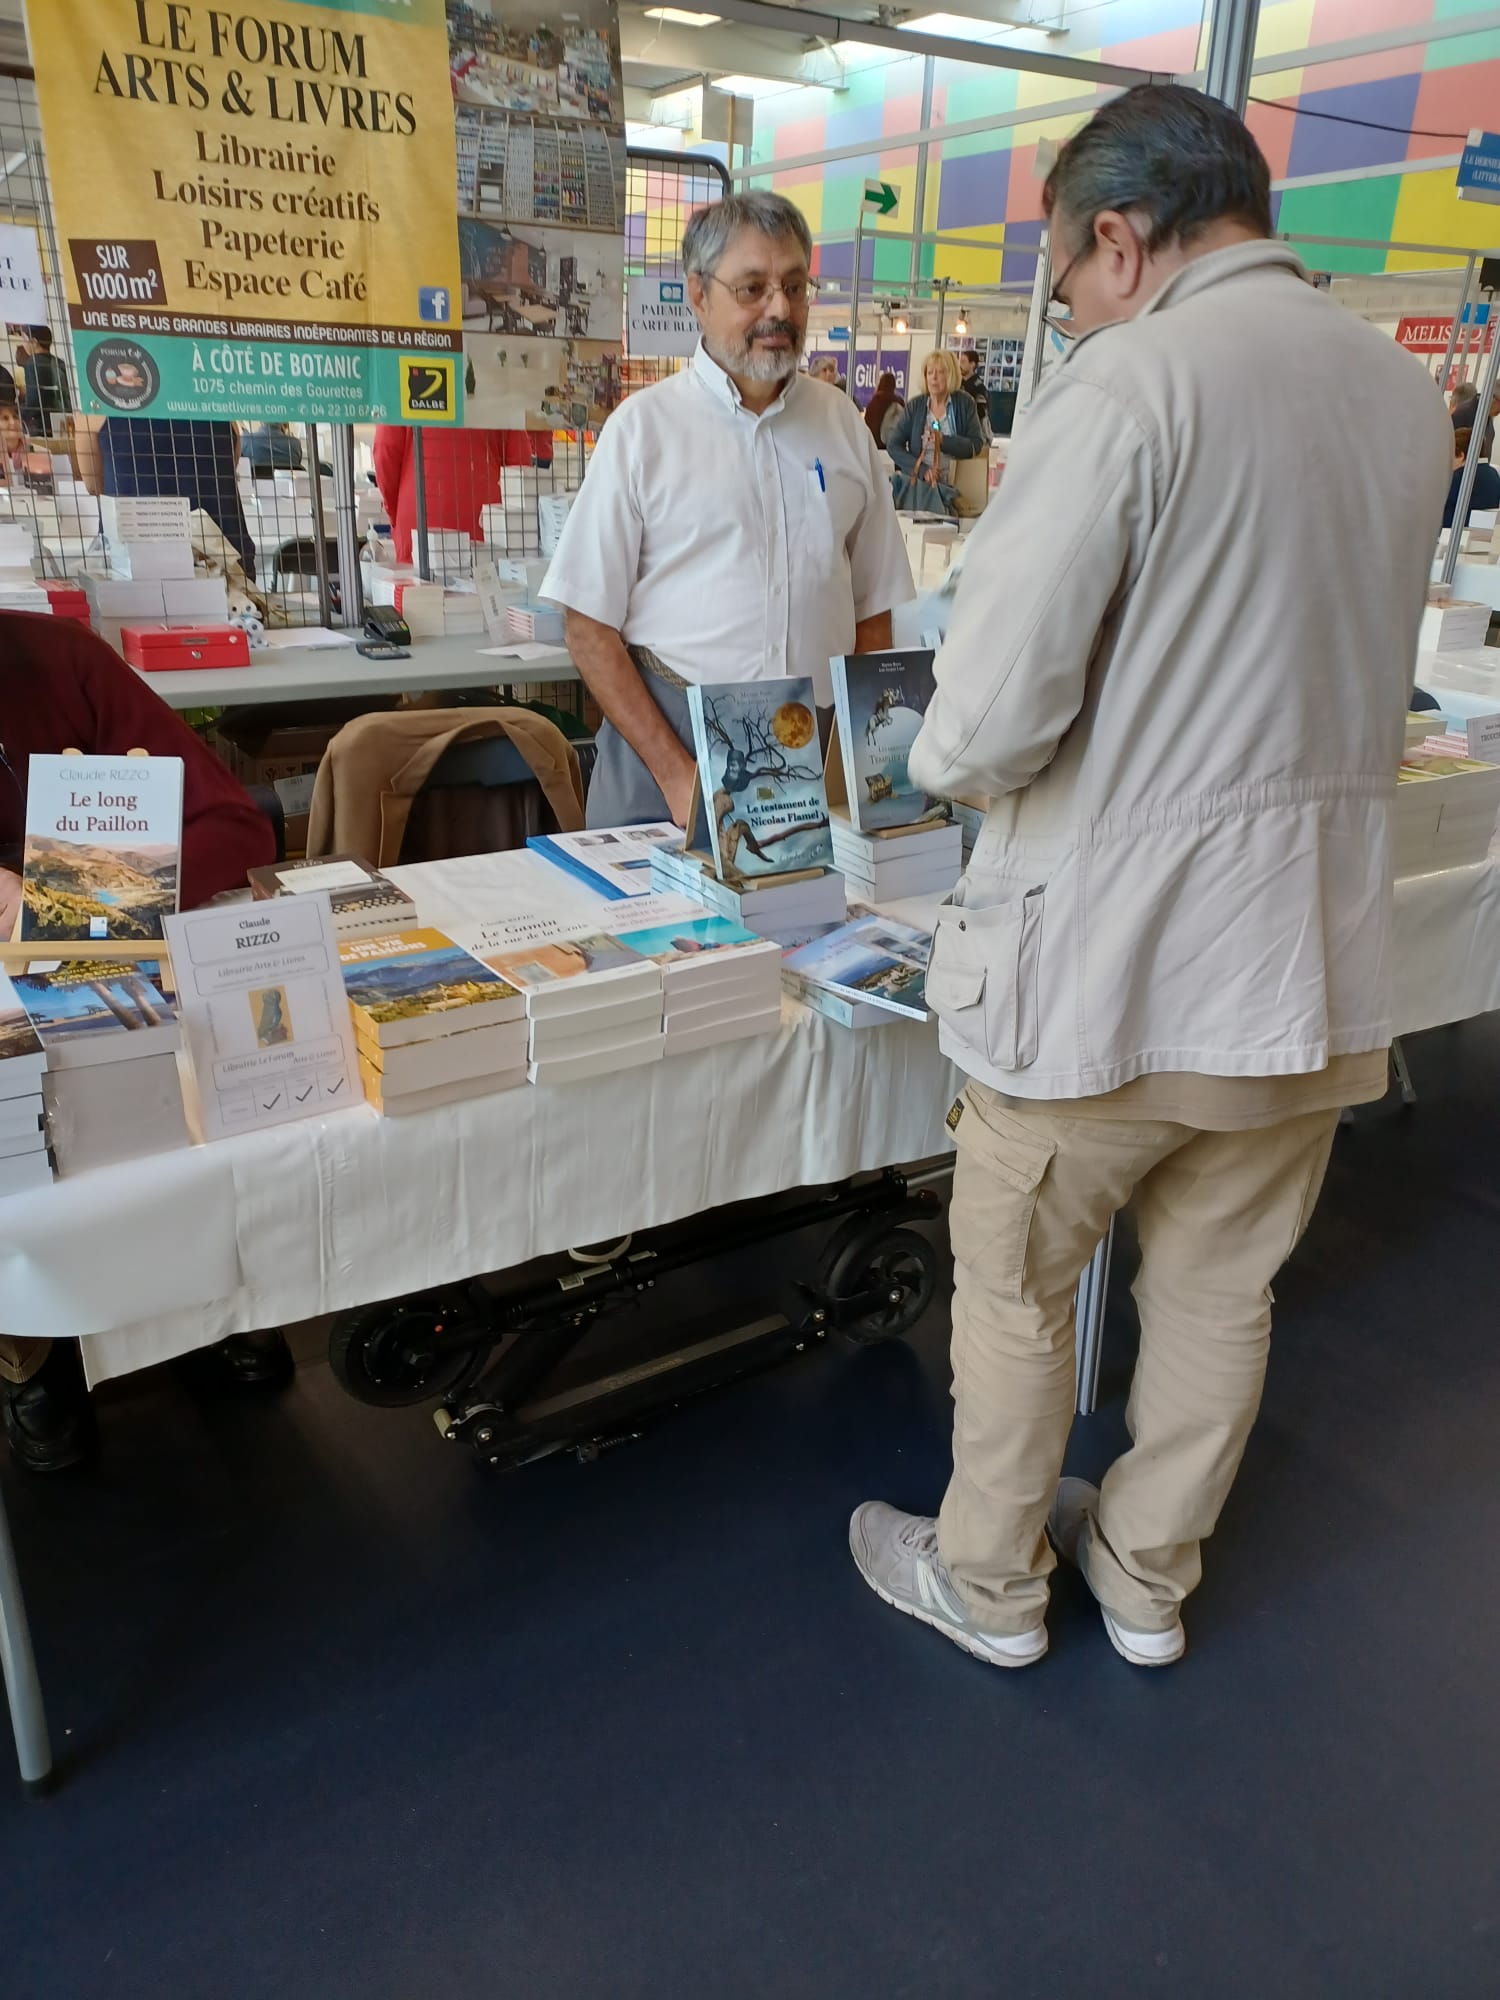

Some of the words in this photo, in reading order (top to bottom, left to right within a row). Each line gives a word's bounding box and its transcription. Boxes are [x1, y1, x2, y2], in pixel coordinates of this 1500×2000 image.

[135, 0, 197, 53] LE
[207, 9, 368, 79] FORUM
[94, 50, 210, 110] ARTS
[221, 70, 256, 116] &
[265, 75, 417, 136] LIVRES
[195, 130, 336, 176] Librairie
[152, 169, 264, 212] Loisirs
[272, 185, 380, 222] créatifs
[200, 219, 345, 260] Papeterie
[96, 244, 130, 270] SUR
[82, 272, 131, 301] 1000
[184, 259, 291, 299] Espace
[300, 268, 368, 301] Café
[641, 303, 694, 317] PAIEMEN
[82, 310, 109, 327] UNE
[111, 313, 137, 329] DES
[139, 315, 171, 331] PLUS
[173, 317, 228, 335] GRANDES
[230, 321, 292, 339] LIBRAIRIES
[293, 323, 379, 343] INDÉPENDANTES
[381, 331, 396, 344] DE
[398, 331, 412, 345] LA
[414, 329, 452, 348] RÉGION
[192, 342, 205, 372] À
[210, 343, 255, 374] CÔTÉ
[261, 352, 285, 376] DE
[290, 353, 362, 380] BOTANIC
[193, 378, 226, 394] 1075
[229, 379, 276, 396] chemin
[281, 382, 303, 397] des
[307, 383, 363, 399] Gourettes
[167, 401, 287, 416] www.artsetlivres.com
[311, 404, 325, 416] 04
[327, 405, 341, 417] 22
[344, 405, 356, 417] 10
[411, 399, 446, 410] DALBE
[59, 767, 107, 781] Claude
[109, 769, 150, 781] RIZZO
[70, 792, 91, 807] Le
[98, 791, 138, 811] long
[746, 804, 759, 814] Le
[761, 799, 807, 812] testament
[809, 797, 820, 806] de
[56, 815, 79, 831] du
[86, 815, 149, 831] Paillon
[750, 814, 786, 827] Nicolas
[787, 809, 819, 822] Flamel
[239, 916, 271, 929] Claude
[481, 930, 498, 940] Le
[504, 919, 558, 934] Gamin
[235, 930, 281, 949] RIZZO
[217, 964, 254, 978] Librairie
